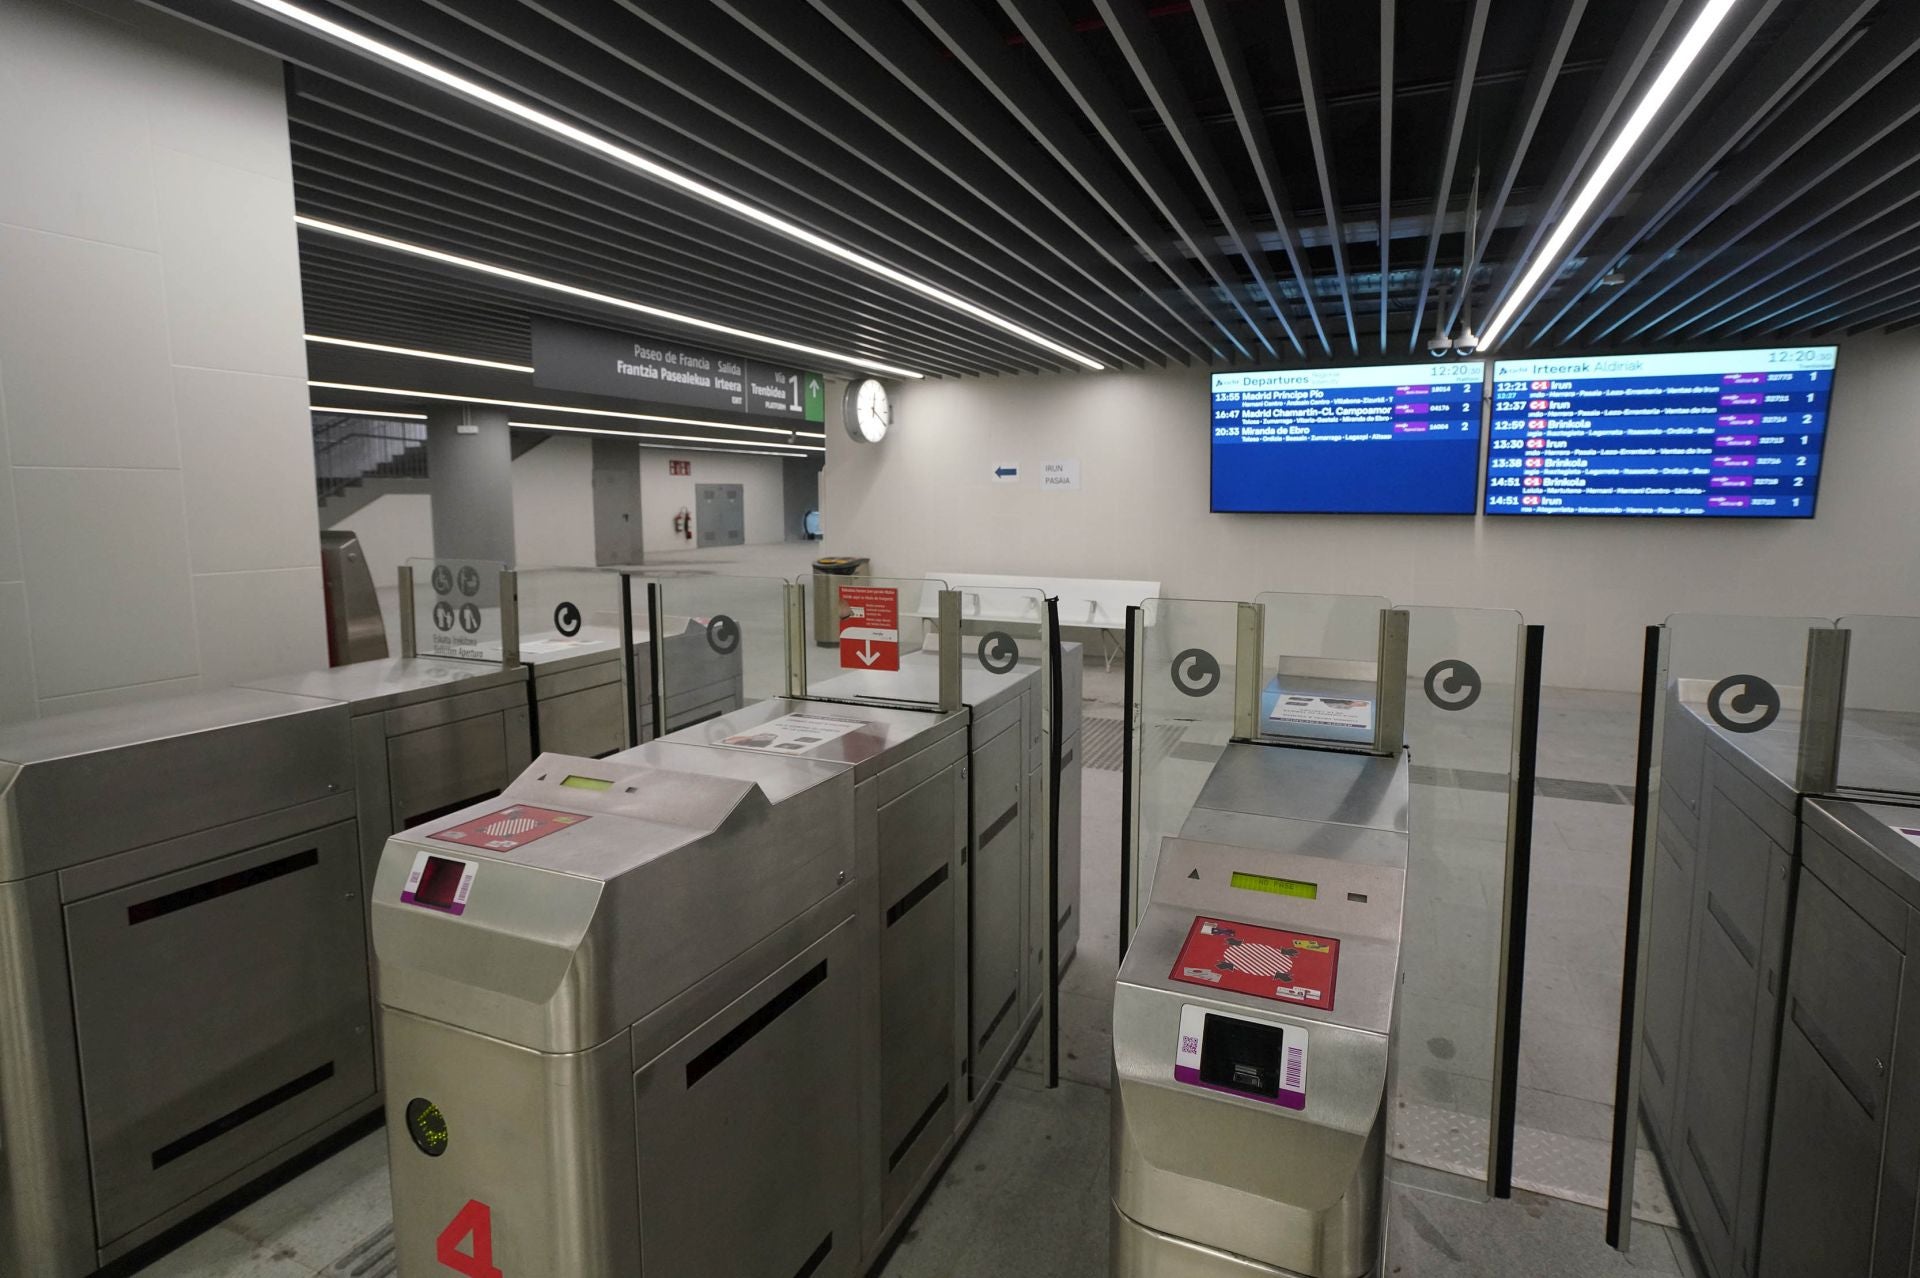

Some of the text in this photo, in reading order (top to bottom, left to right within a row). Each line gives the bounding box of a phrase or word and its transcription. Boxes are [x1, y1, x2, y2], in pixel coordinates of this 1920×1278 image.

[634, 344, 710, 370] Paseo de Francia
[718, 360, 741, 376] Salida
[1431, 365, 1468, 376] 12:20
[1533, 362, 1589, 374] Irteerak
[617, 360, 710, 387] Frantzia Pasealekua
[1809, 372, 1817, 381] 1
[715, 377, 742, 392] Irteera
[1244, 376, 1309, 387] Departures
[1497, 382, 1528, 392] 12:21
[1551, 381, 1572, 389] Irun
[751, 382, 786, 399] Trenbidea
[788, 375, 802, 412] 1
[1463, 384, 1471, 393] 2
[1215, 388, 1324, 402] 13:55 Madrid Príncipe Pío
[1806, 393, 1814, 402] 1
[1462, 403, 1470, 412] 2
[1496, 401, 1527, 411] 12:37
[1549, 400, 1570, 409] Irun
[1215, 410, 1240, 419] 16:47
[1242, 409, 1272, 418] Madrid
[1336, 406, 1392, 416] Campoamor
[1802, 414, 1812, 424] 2
[1461, 422, 1469, 431] 2
[1494, 421, 1525, 430] 12:59
[1547, 420, 1591, 428] Brinkola
[1215, 426, 1310, 436] 20:33 Miranda de Ebro
[1493, 440, 1524, 449] 13:30
[1546, 440, 1567, 448] Irun
[1800, 435, 1808, 445] 1
[1544, 458, 1588, 467] Brinkola
[1796, 456, 1807, 466] 2
[1490, 478, 1520, 486] 14:51
[1542, 477, 1586, 486] Brinkola
[1793, 477, 1804, 487] 2
[1489, 496, 1519, 505] 14:51
[1541, 496, 1562, 505] Irun
[1792, 497, 1800, 507] 1
[1274, 881, 1295, 890] PASE
[436, 1199, 503, 1278] 4
